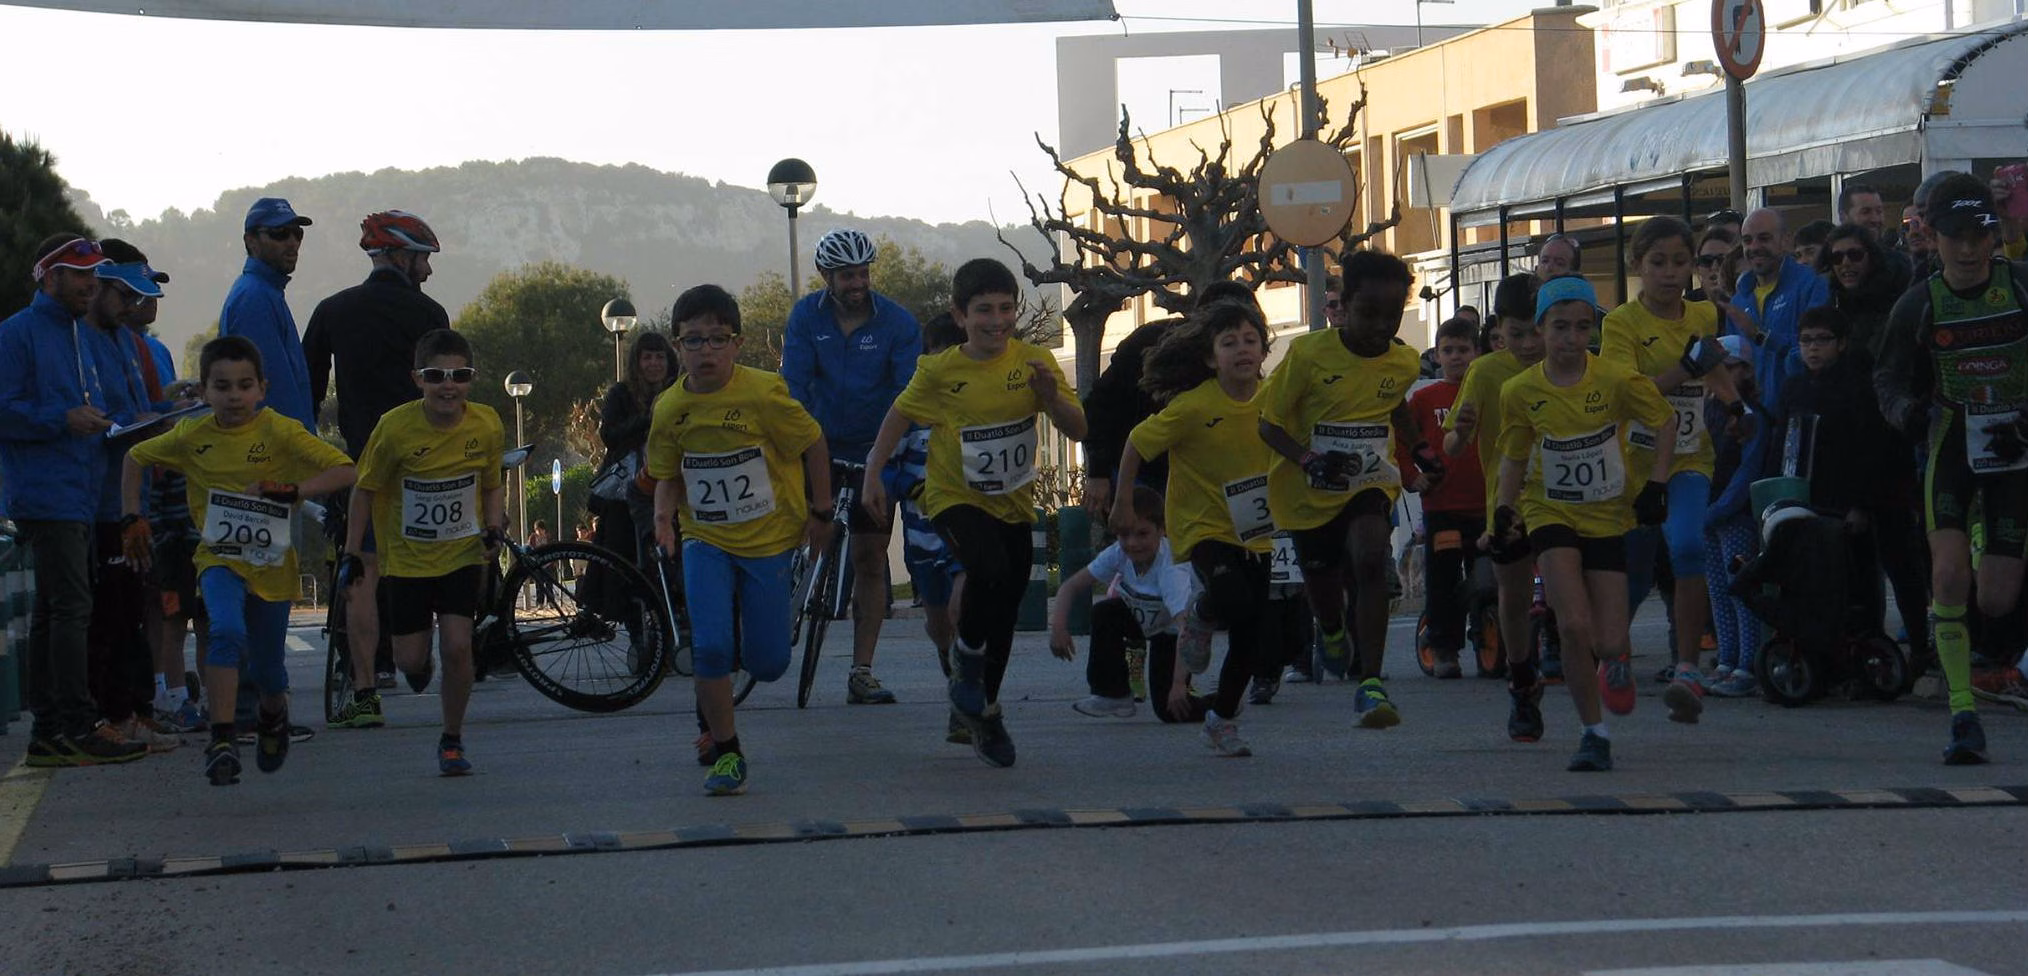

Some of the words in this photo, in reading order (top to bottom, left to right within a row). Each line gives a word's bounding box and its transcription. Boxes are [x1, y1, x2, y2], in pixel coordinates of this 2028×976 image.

[978, 444, 1027, 474] 210
[1555, 457, 1607, 487] 201
[698, 475, 754, 504] 212
[414, 501, 463, 525] 208
[216, 520, 272, 549] 209
